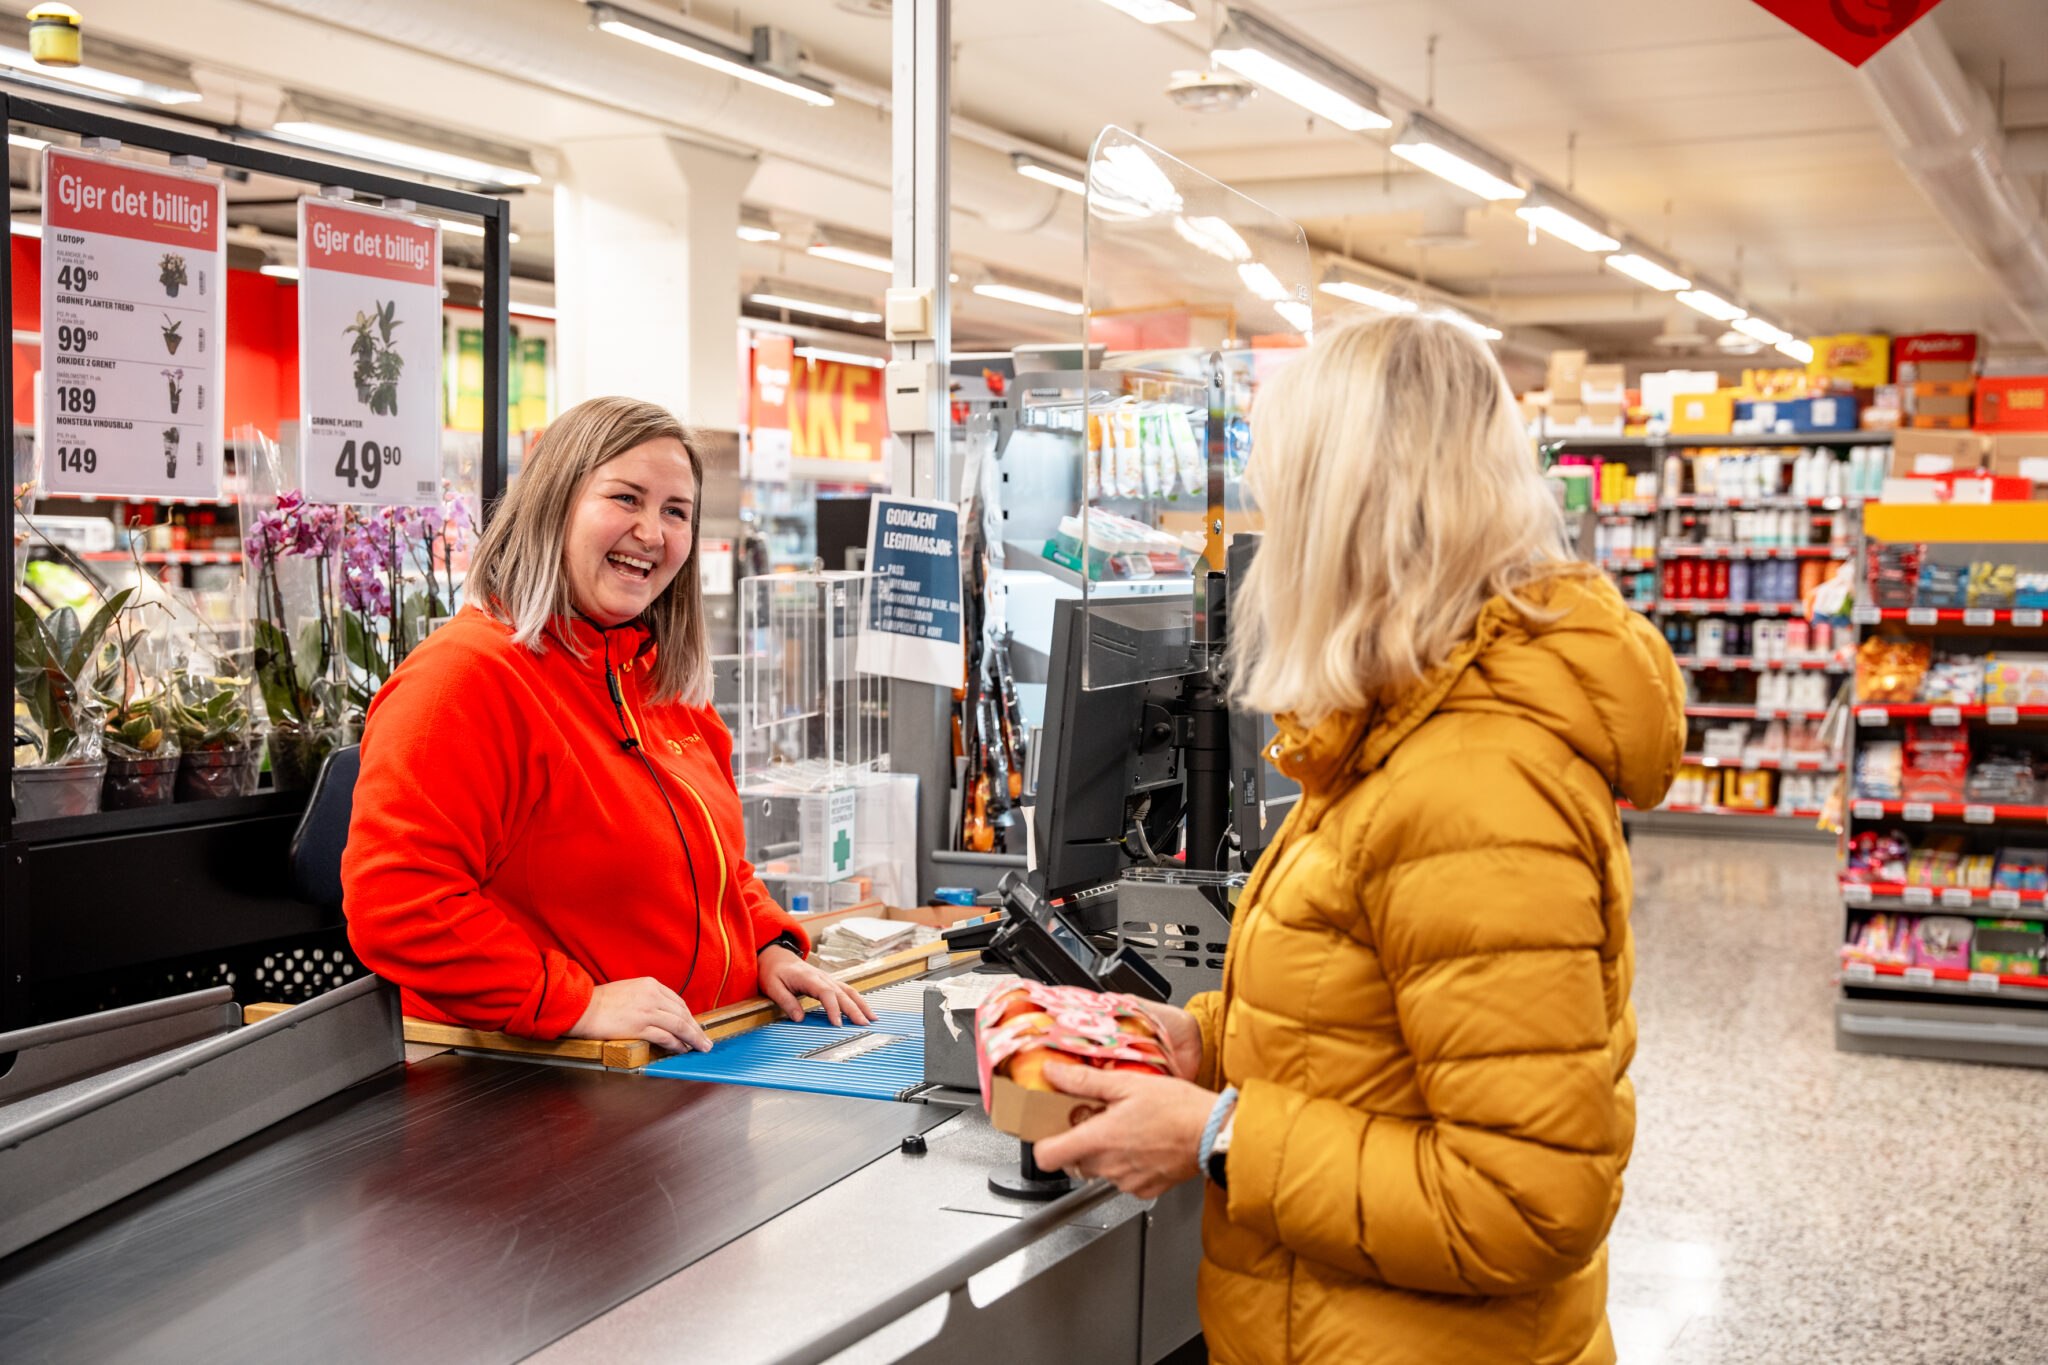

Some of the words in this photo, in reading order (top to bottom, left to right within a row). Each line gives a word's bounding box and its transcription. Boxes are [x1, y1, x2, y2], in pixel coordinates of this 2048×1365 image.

[58, 174, 106, 213] Gjer
[112, 184, 148, 218] det
[152, 192, 208, 232] billig!
[56, 234, 85, 245] ILDTOPP
[312, 222, 350, 256] Gjer
[353, 230, 382, 259] det
[385, 234, 430, 270] billig!
[56, 295, 84, 307] GRØNNE
[84, 298, 113, 310] PLANTER
[114, 302, 134, 312] TREND
[56, 356, 86, 368] ORKIDEE
[86, 359, 91, 368] 2
[92, 360, 116, 369] GRENET
[57, 386, 96, 414] 189
[56, 416, 92, 427] MONSTERA
[93, 420, 133, 430] VINDUSBLAD
[312, 416, 336, 428] GRØNNE
[336, 418, 363, 429] PLANTER
[57, 447, 96, 474] 149
[886, 507, 938, 530] GODKJENT
[883, 531, 954, 557] LEGITIMASJON:
[887, 564, 905, 576] PASS
